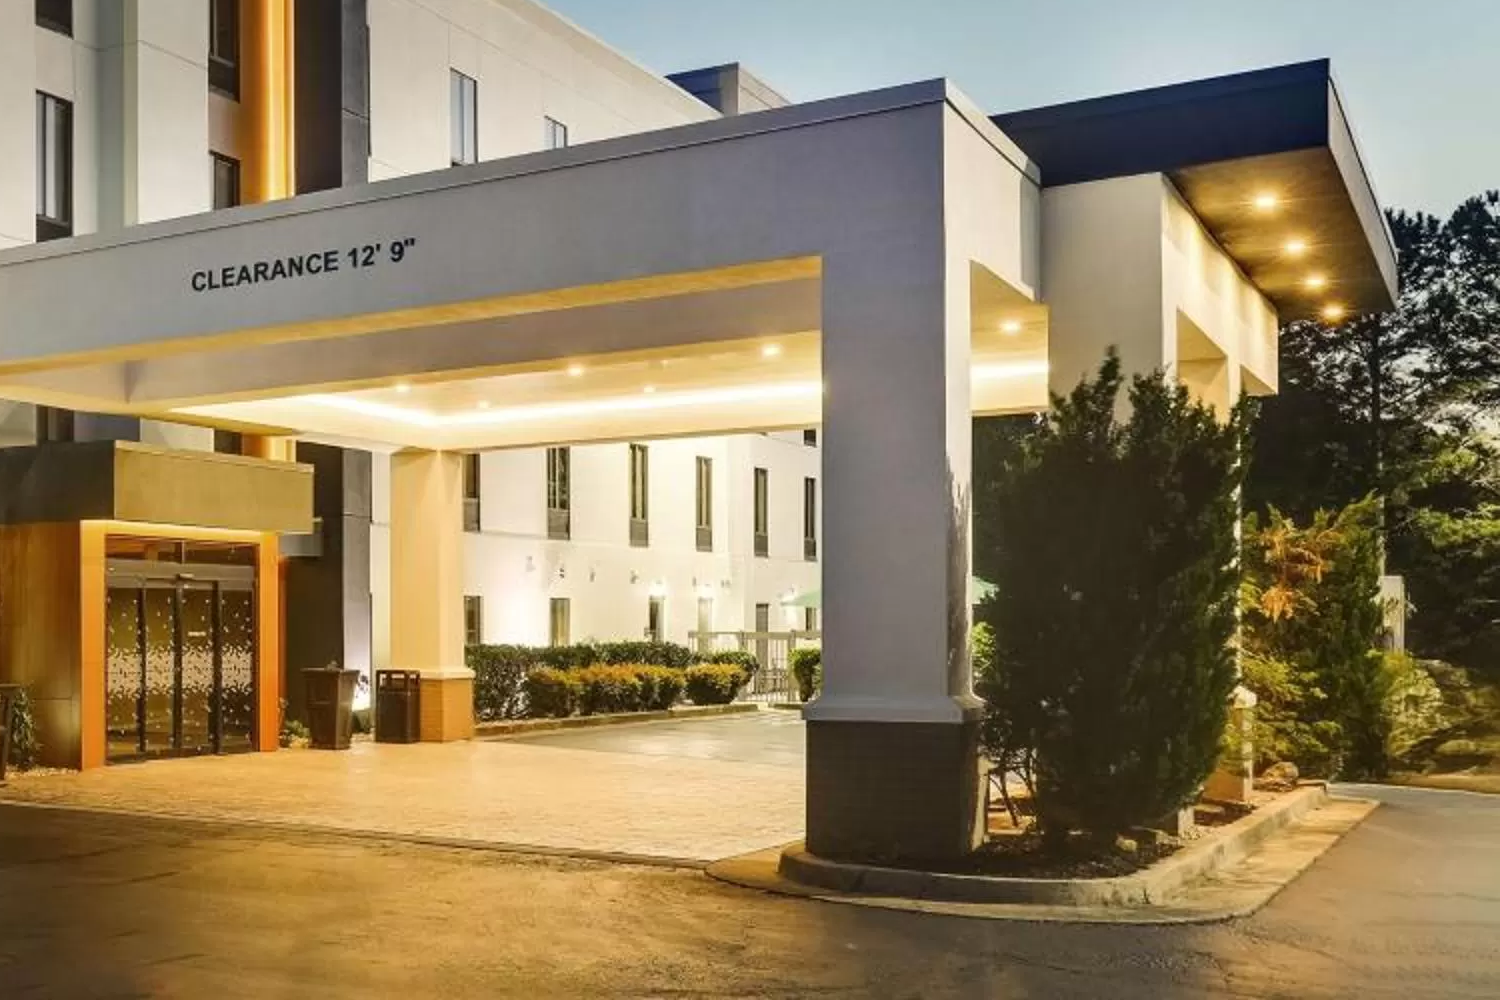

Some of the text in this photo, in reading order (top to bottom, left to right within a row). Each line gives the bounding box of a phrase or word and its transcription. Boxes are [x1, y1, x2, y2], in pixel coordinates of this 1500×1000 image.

[191, 237, 416, 292] CLEARANCE 12' 9"
